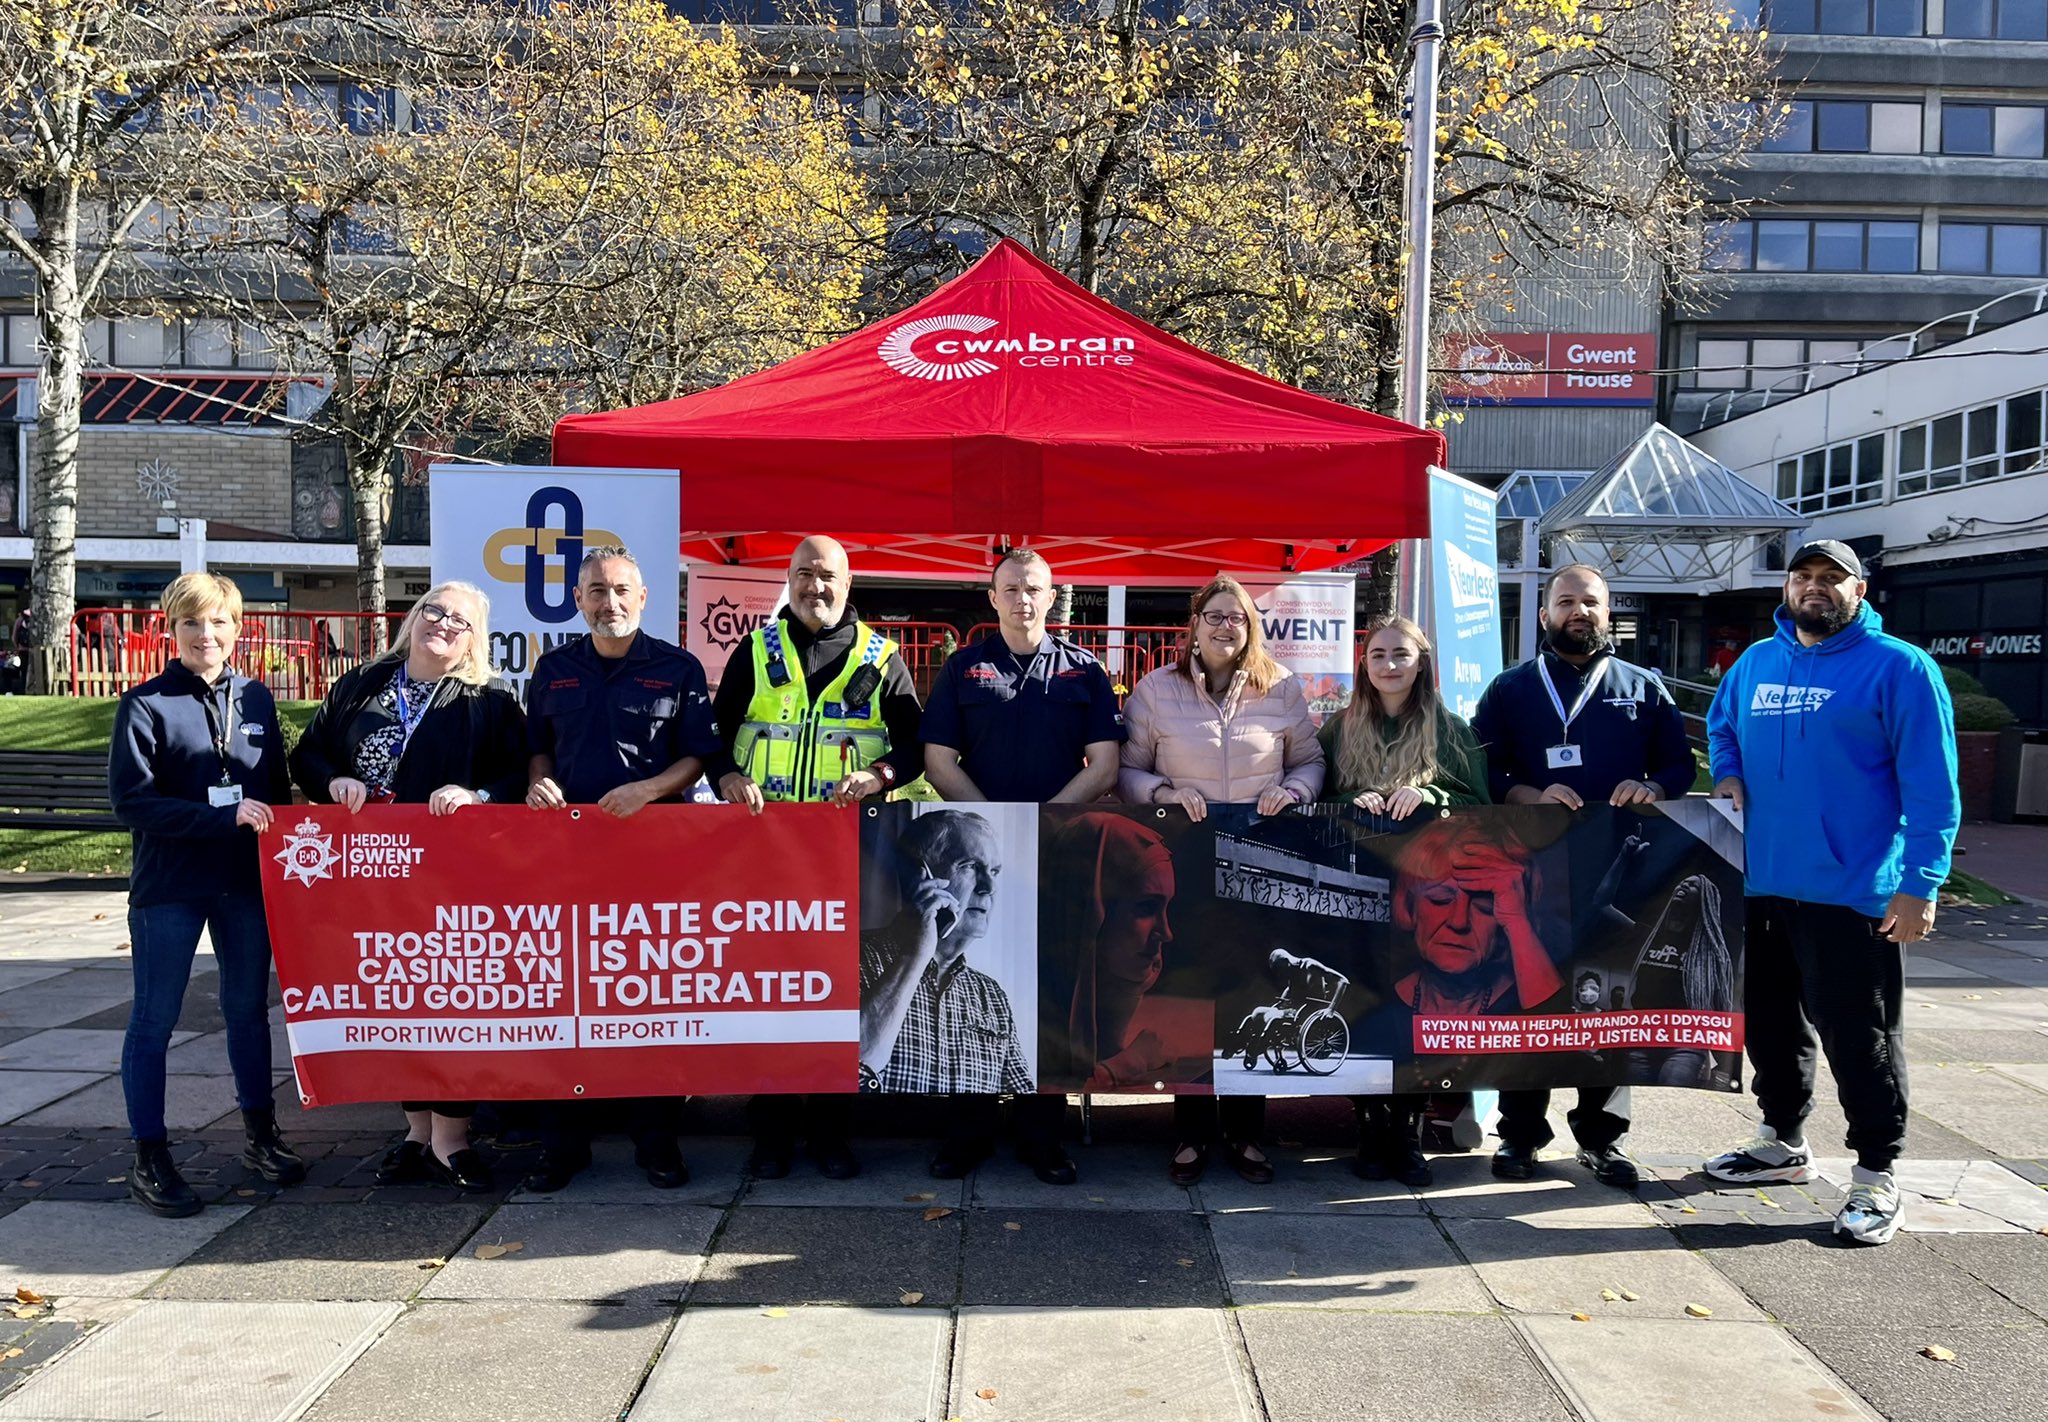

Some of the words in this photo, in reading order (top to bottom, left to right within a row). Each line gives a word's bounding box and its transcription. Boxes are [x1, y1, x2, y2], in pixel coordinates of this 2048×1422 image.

[935, 333, 1135, 354] cwmbran
[1567, 344, 1637, 364] Gwent
[1018, 353, 1135, 368] centre
[1567, 368, 1633, 388] House
[1261, 618, 1347, 641] WENT
[1927, 637, 1970, 655] JACK
[1985, 635, 2042, 654] JONES
[1455, 656, 1470, 683] Are
[351, 834, 410, 847] HEDDLU
[349, 848, 424, 864] GWENT
[350, 865, 410, 878] POLICE
[436, 905, 495, 930] NID
[503, 905, 561, 930] YW
[589, 903, 700, 936] HATE
[712, 900, 845, 933] CRIME
[353, 931, 562, 958] TROSEDDAU
[590, 939, 627, 972] IS
[639, 937, 730, 971] NOT
[358, 958, 506, 984] CASINEB
[513, 957, 562, 982] YN
[283, 984, 367, 1014] CAEL
[374, 985, 414, 1010] EU
[423, 983, 563, 1010] GODDEF
[589, 970, 832, 1007] TOLERATED
[591, 1020, 679, 1040] REPORT
[685, 1019, 710, 1038] IT.
[1422, 1020, 1468, 1031] RYDYN
[1472, 1020, 1486, 1031] NI
[1489, 1020, 1519, 1031] YMA
[1522, 1020, 1526, 1031] I
[1530, 1018, 1572, 1031] HELPU,
[1575, 1018, 1578, 1029] I
[1581, 1015, 1639, 1029] WRANDO
[1641, 1014, 1661, 1025] AC
[1664, 1014, 1668, 1025] I
[1671, 1014, 1732, 1028] DDYSGU
[345, 1026, 492, 1043] RIPORTIWCH
[499, 1025, 564, 1042] NHW.
[1422, 1034, 1476, 1049] WE’RE
[1480, 1034, 1522, 1048] HERE
[1526, 1033, 1549, 1047] TO
[1553, 1032, 1596, 1047] HELP,
[1599, 1028, 1651, 1044] LISTEN
[1655, 1028, 1669, 1043] &
[1674, 1029, 1732, 1046] LEARN
